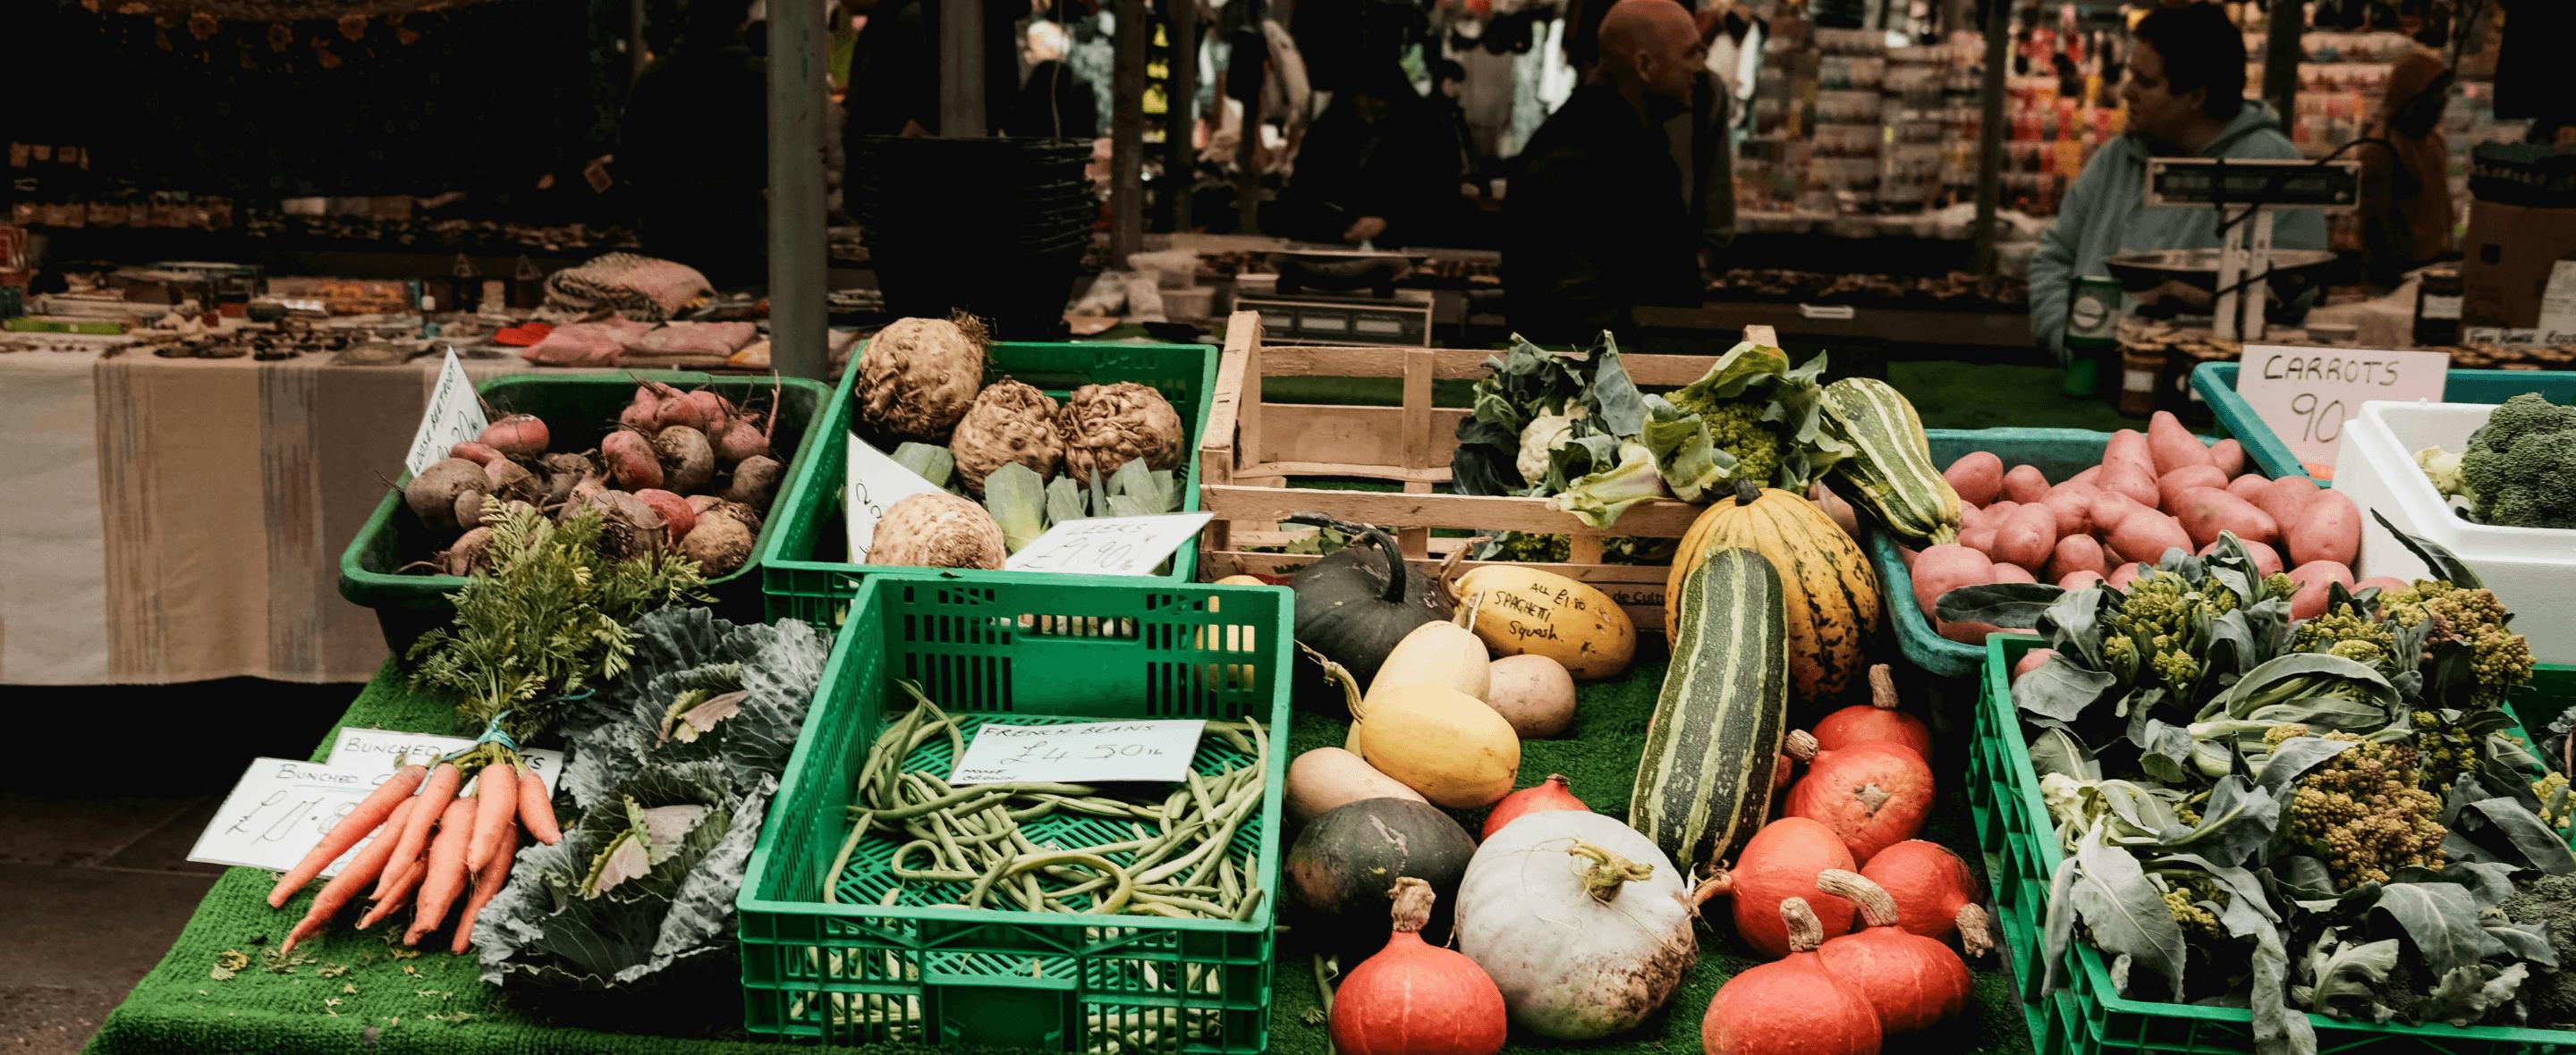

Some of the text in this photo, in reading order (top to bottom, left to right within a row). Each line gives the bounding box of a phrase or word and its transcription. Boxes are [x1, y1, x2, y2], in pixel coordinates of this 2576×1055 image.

[2264, 354, 2400, 386] CARROTS
[2291, 393, 2345, 443] 90
[413, 430, 431, 474] LOOSE
[1065, 522, 1148, 536] LEEKS
[1494, 590, 1551, 623] SPAGHETTI
[1613, 590, 1630, 602] de
[983, 723, 1156, 738] FRENCH BEANS
[343, 737, 442, 758] BUNCHED
[274, 763, 359, 784] BUNCHED
